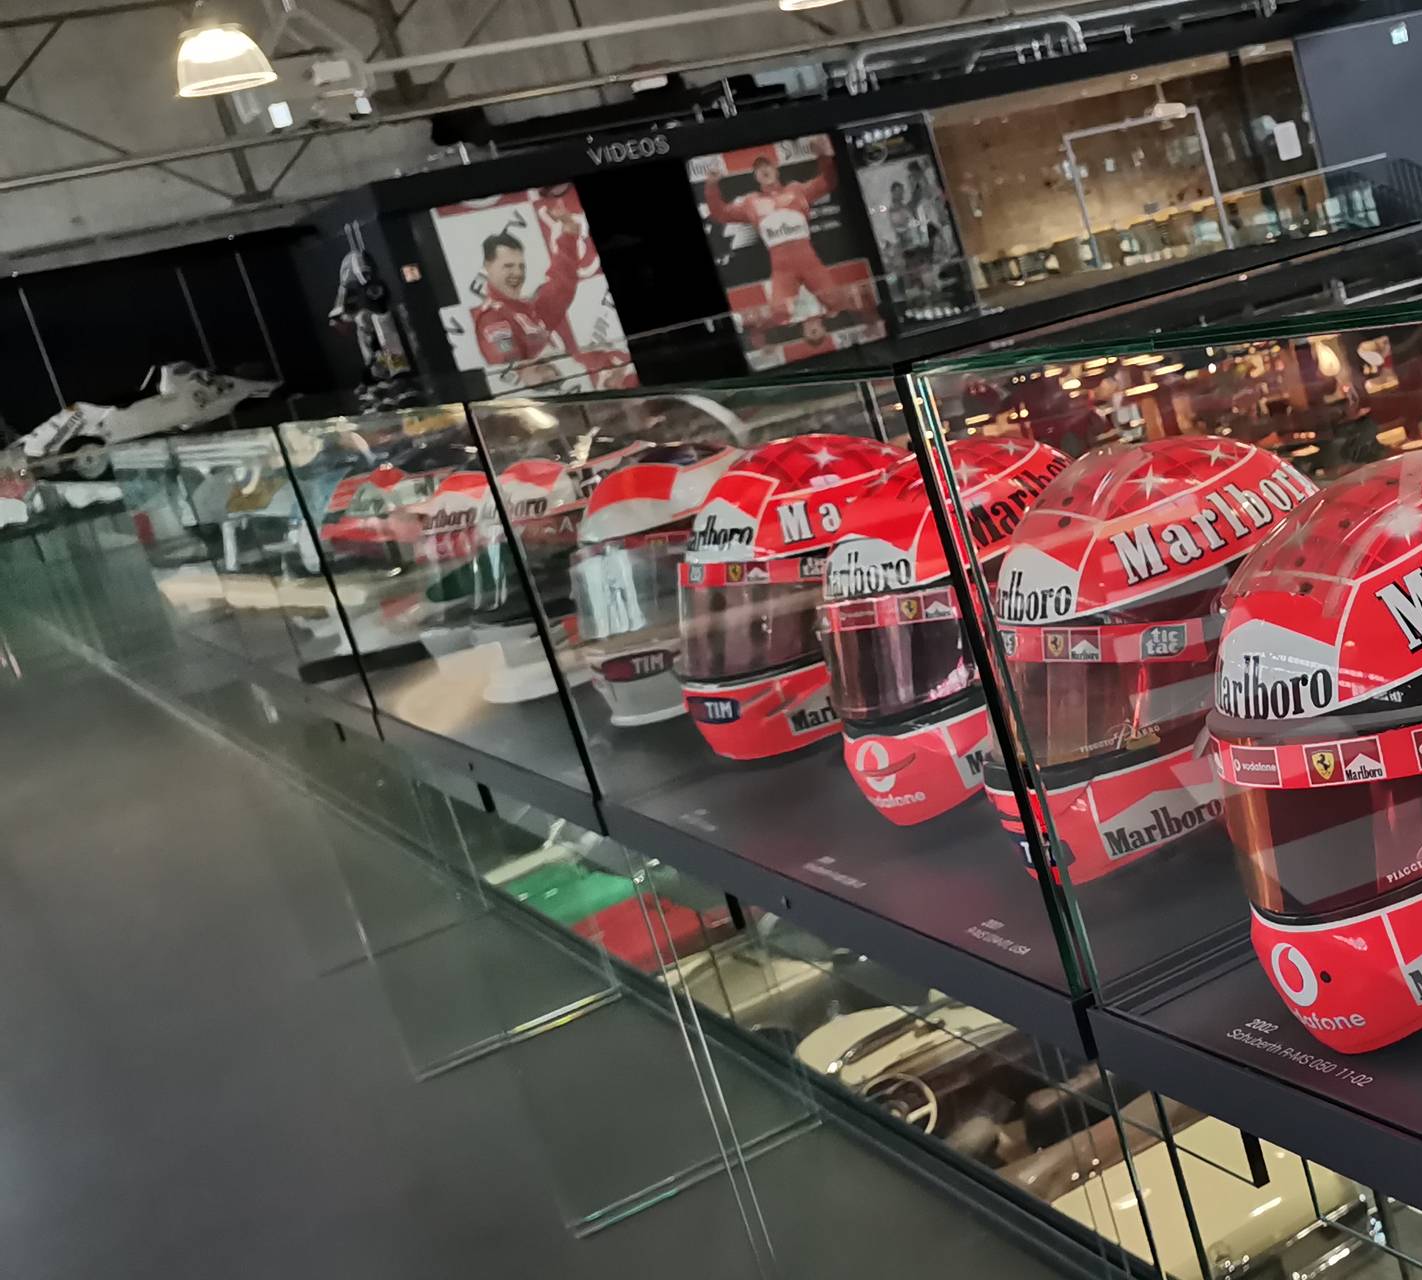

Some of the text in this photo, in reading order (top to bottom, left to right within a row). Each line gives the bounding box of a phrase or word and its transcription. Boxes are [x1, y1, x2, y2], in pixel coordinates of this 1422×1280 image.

[586, 134, 670, 166] VIDEOS
[687, 514, 754, 552] arlboro
[827, 551, 912, 597] arlboro
[1150, 626, 1180, 643] tic
[1145, 639, 1181, 656] tac
[704, 700, 734, 719] TIM
[1344, 764, 1384, 781] Marlboro
[1103, 798, 1223, 856] Marlboro
[1245, 1018, 1279, 1034] 2002
[1226, 1028, 1282, 1055] Schuberth
[1335, 1067, 1374, 1087] 11-02
